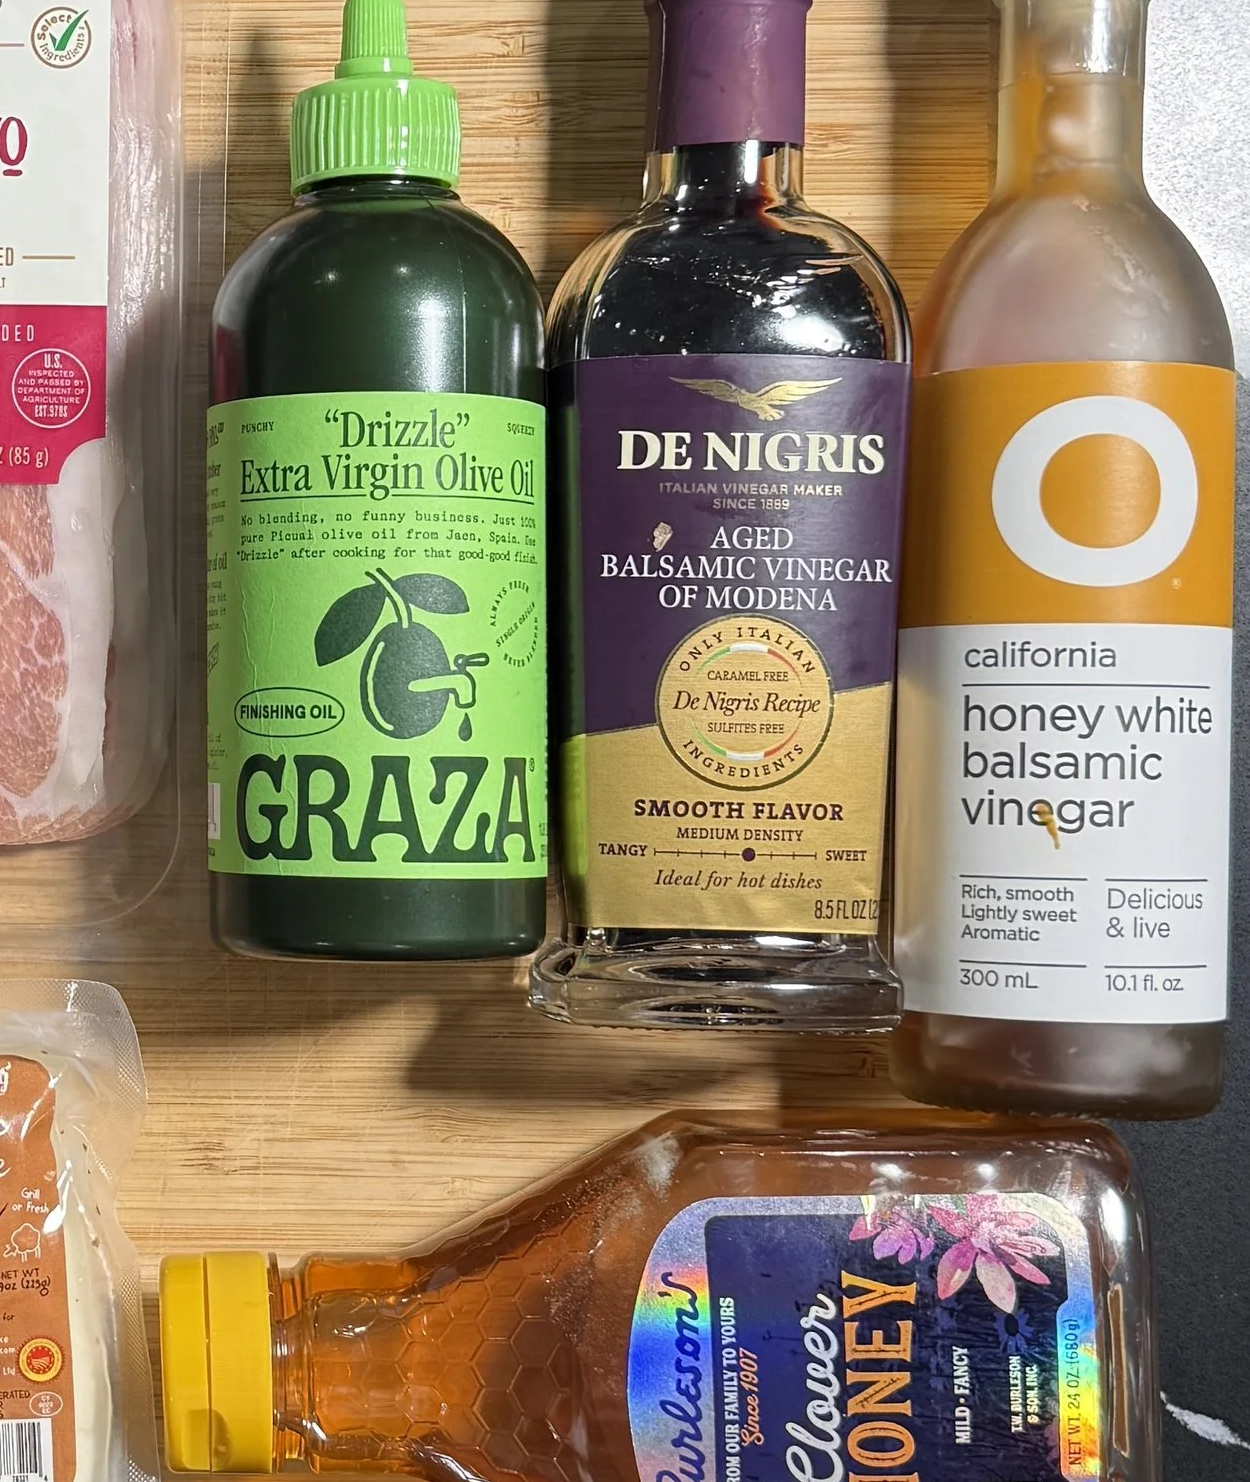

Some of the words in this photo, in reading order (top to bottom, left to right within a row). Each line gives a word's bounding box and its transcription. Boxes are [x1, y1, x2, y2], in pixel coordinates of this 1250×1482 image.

[8, 446, 32, 467] (85
[36, 447, 49, 468] g)
[616, 430, 693, 471] DE
[702, 432, 885, 474] NIGRIS
[240, 460, 312, 495] Extra
[321, 453, 422, 501] Virgin
[436, 452, 504, 494] Olive
[511, 459, 534, 497] Oil
[659, 482, 718, 495] ITALIAN
[723, 483, 788, 496] VINEGAR
[794, 484, 843, 496] MAKER
[991, 395, 1199, 588] O
[241, 514, 253, 526] No
[259, 513, 325, 525] blending,
[336, 514, 352, 522] no
[363, 510, 405, 524] funny
[415, 510, 485, 524] business.
[493, 514, 516, 526] Just
[710, 525, 793, 550] AGED
[600, 554, 756, 580] BALSAMIC
[763, 557, 893, 583] VINEGAR
[659, 584, 696, 608] OF
[706, 586, 837, 611] MODENA
[680, 632, 724, 672] ONLY
[737, 627, 815, 675] ITALIAN
[964, 641, 1117, 668] california
[240, 705, 306, 719] FINISHING
[310, 704, 337, 719] OIL
[673, 690, 700, 710] De
[704, 691, 759, 716] Nigris
[762, 694, 821, 718] Recipe
[963, 695, 1105, 739] honey
[1115, 696, 1212, 734] white
[683, 739, 805, 779] INGREDIENTS
[962, 741, 1163, 780] balsamic
[237, 754, 536, 862] GRAZA
[634, 799, 745, 820] SMOOTH
[752, 803, 844, 821] FLAVOR
[960, 789, 1135, 834] vinegar
[676, 827, 739, 840] MEDIUM
[743, 829, 803, 842] DENSITY
[599, 843, 647, 857] TANGY
[826, 850, 867, 862] SWEET
[654, 869, 702, 887] Ideal
[701, 872, 732, 891] for
[737, 873, 765, 888] hot
[771, 873, 823, 889] dishes
[961, 884, 1002, 902] Rich,
[1005, 886, 1074, 902] smooth
[814, 900, 834, 919] 8.5
[836, 900, 849, 919] FL
[852, 900, 867, 920] OZ
[1107, 887, 1203, 910] Delicious
[961, 904, 1018, 923] Lightly
[1022, 908, 1077, 922] sweet
[961, 925, 1040, 942] Aromatic
[1105, 917, 1124, 938] &
[1132, 916, 1171, 939] live
[960, 969, 999, 987] 300
[1004, 970, 1038, 990] mL
[1105, 976, 1138, 991] 10.1
[1142, 975, 1158, 992] fl.
[719, 1296, 736, 1345] YOURS
[721, 1347, 736, 1366] TO
[738, 1346, 758, 1391] 1907
[952, 1345, 969, 1395] FANCY
[723, 1369, 738, 1419] FAMILY
[740, 1392, 764, 1445] Since
[954, 1406, 971, 1443] MILD
[725, 1423, 740, 1452] OUR
